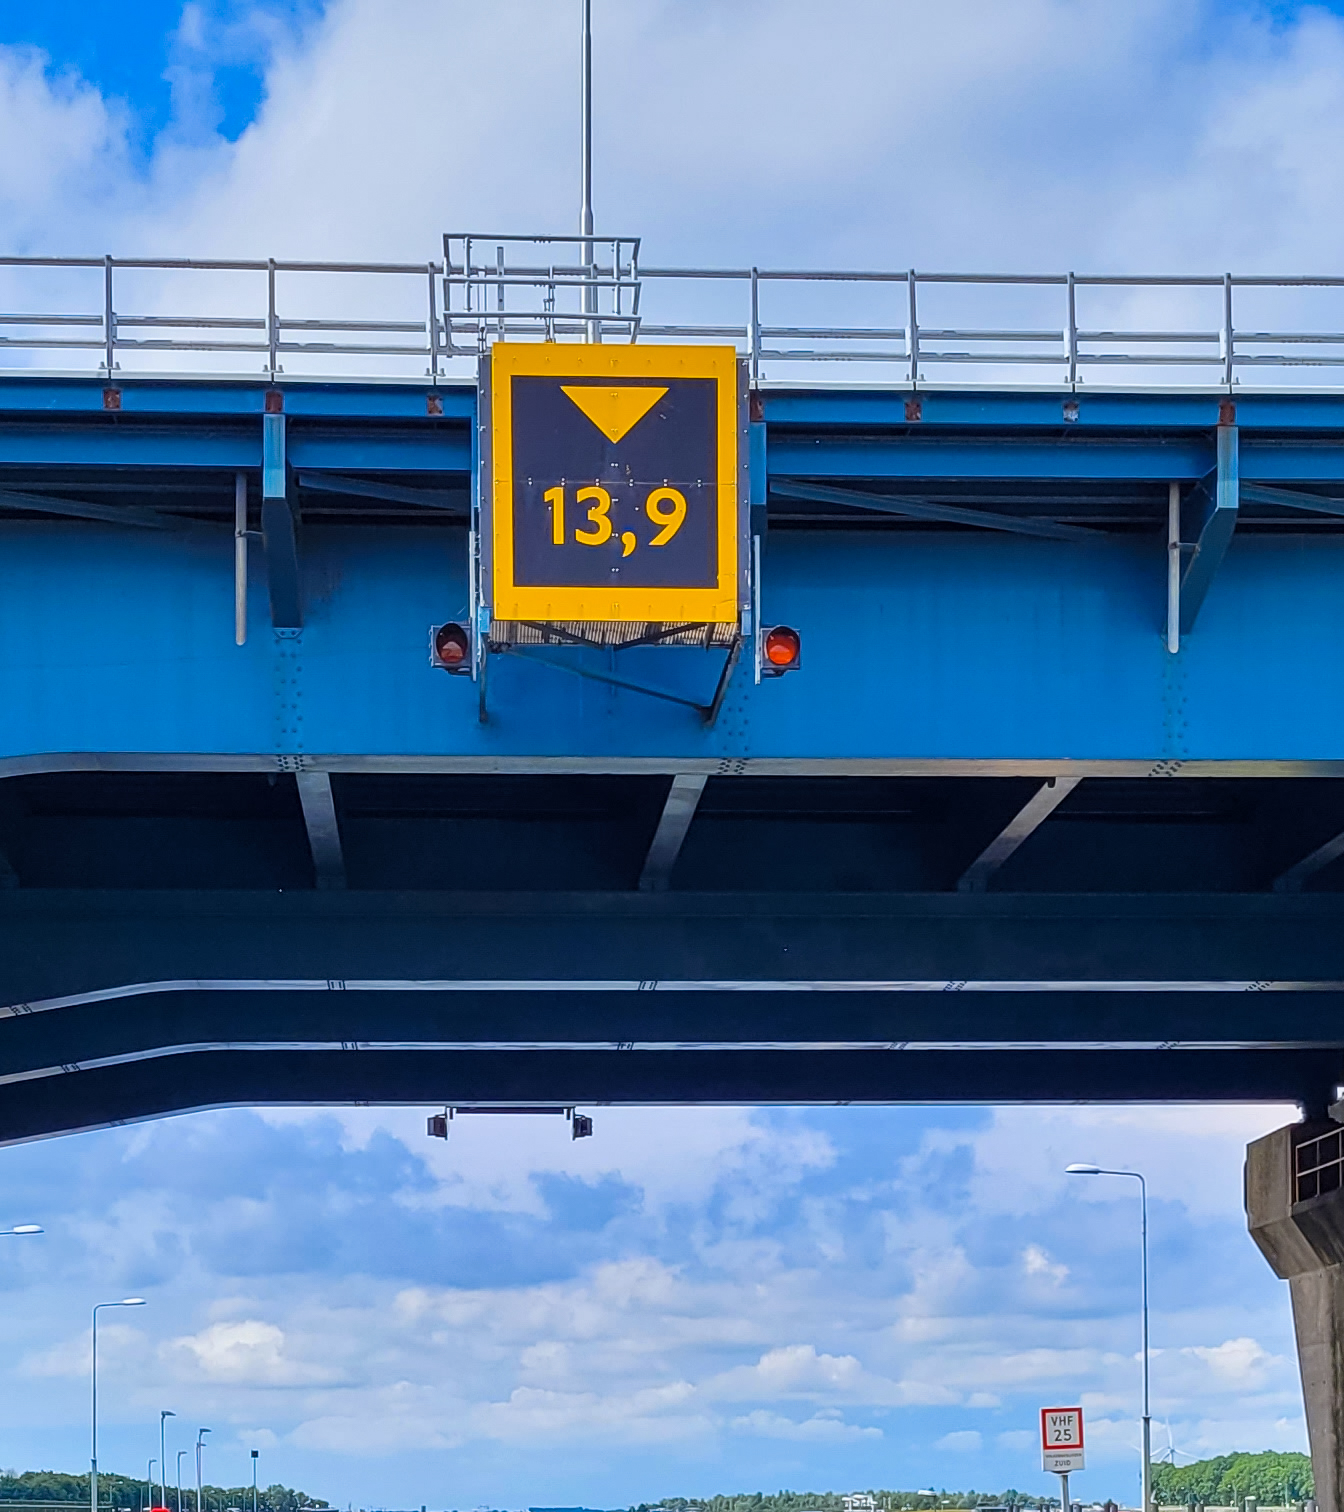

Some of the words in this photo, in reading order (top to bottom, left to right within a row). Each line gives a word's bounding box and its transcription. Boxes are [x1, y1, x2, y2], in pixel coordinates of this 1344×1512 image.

[543, 486, 687, 557] 13,9
[1050, 1415, 1074, 1427] VHF
[1053, 1429, 1072, 1442] 25
